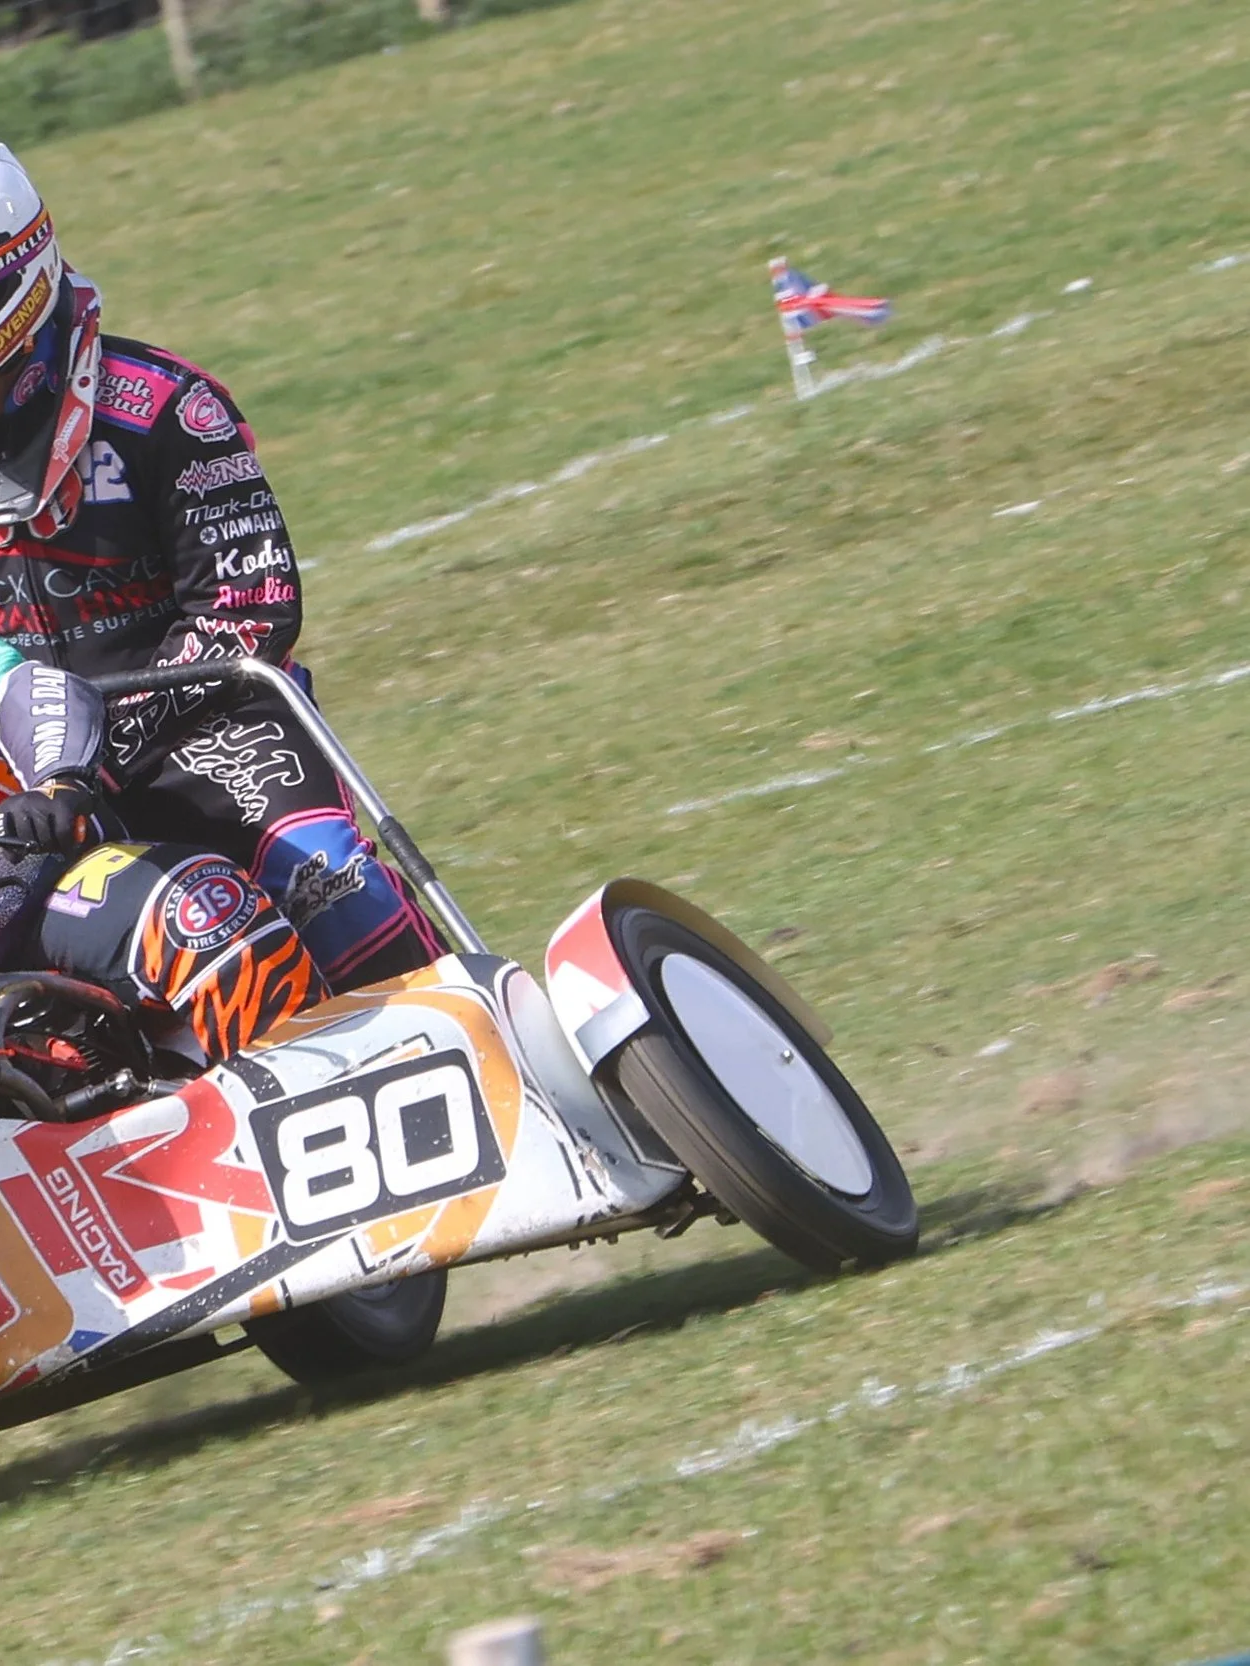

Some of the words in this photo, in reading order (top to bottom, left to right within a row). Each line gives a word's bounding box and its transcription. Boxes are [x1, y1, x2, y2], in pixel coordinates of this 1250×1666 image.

[96, 386, 154, 419] Bud
[218, 511, 283, 540] YAMAHA
[214, 539, 291, 580] Kody
[213, 576, 296, 610] Amelia
[92, 597, 177, 635] SUPPLIE
[31, 667, 67, 700] DAD
[31, 703, 67, 717] &
[186, 882, 233, 929] STS
[186, 933, 218, 950] TYRE
[276, 1063, 480, 1227] 80
[46, 1166, 137, 1291] RACING
